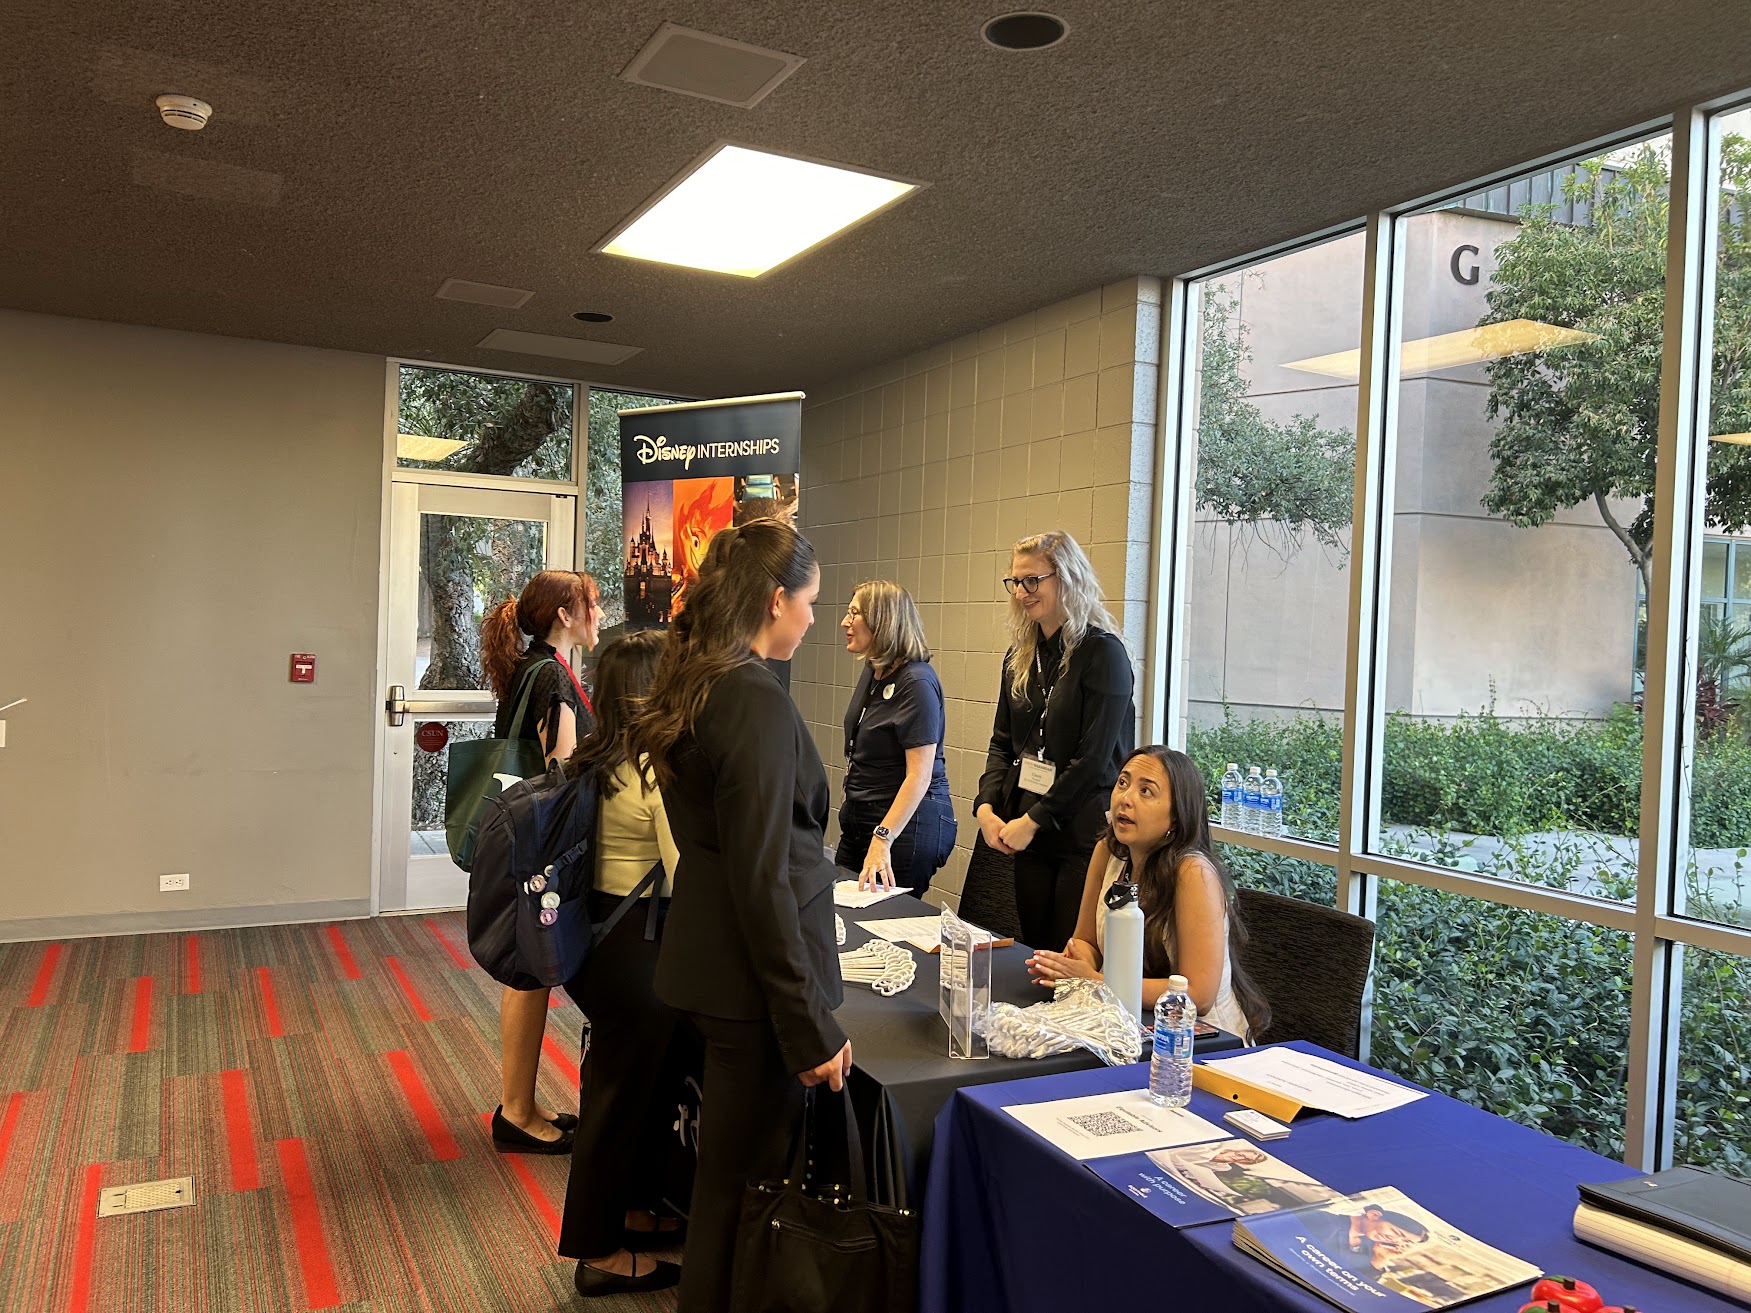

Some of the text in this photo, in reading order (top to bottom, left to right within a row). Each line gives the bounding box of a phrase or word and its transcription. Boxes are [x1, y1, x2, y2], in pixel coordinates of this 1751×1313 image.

[1450, 244, 1480, 286] G
[633, 434, 780, 471] Disney INTERNSHIPS
[1138, 1172, 1156, 1184] with
[1152, 1183, 1187, 1205] purpose
[1161, 1180, 1188, 1198] career
[1295, 1236, 1387, 1298] A career on your
[1301, 1249, 1325, 1269] own
[1325, 1267, 1360, 1292] terms
